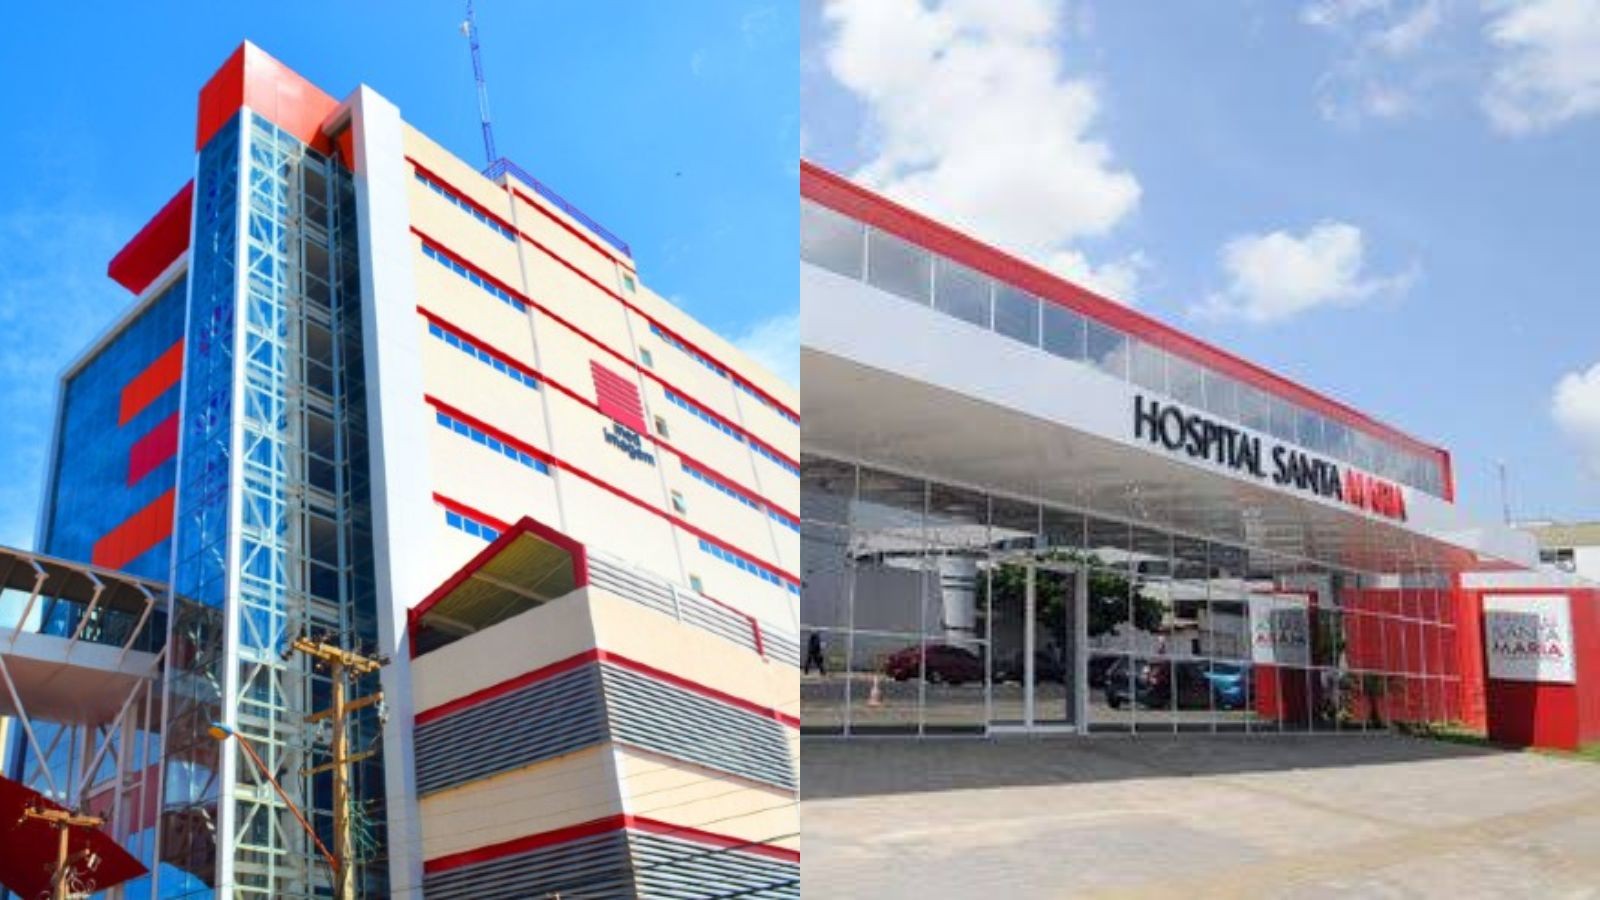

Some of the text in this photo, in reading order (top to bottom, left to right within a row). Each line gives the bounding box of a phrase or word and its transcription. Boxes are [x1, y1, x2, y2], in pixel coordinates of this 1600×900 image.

[1134, 395, 1267, 478] HOSPITAL
[1272, 445, 1343, 501] SANTA
[1491, 641, 1565, 658] MARIA
